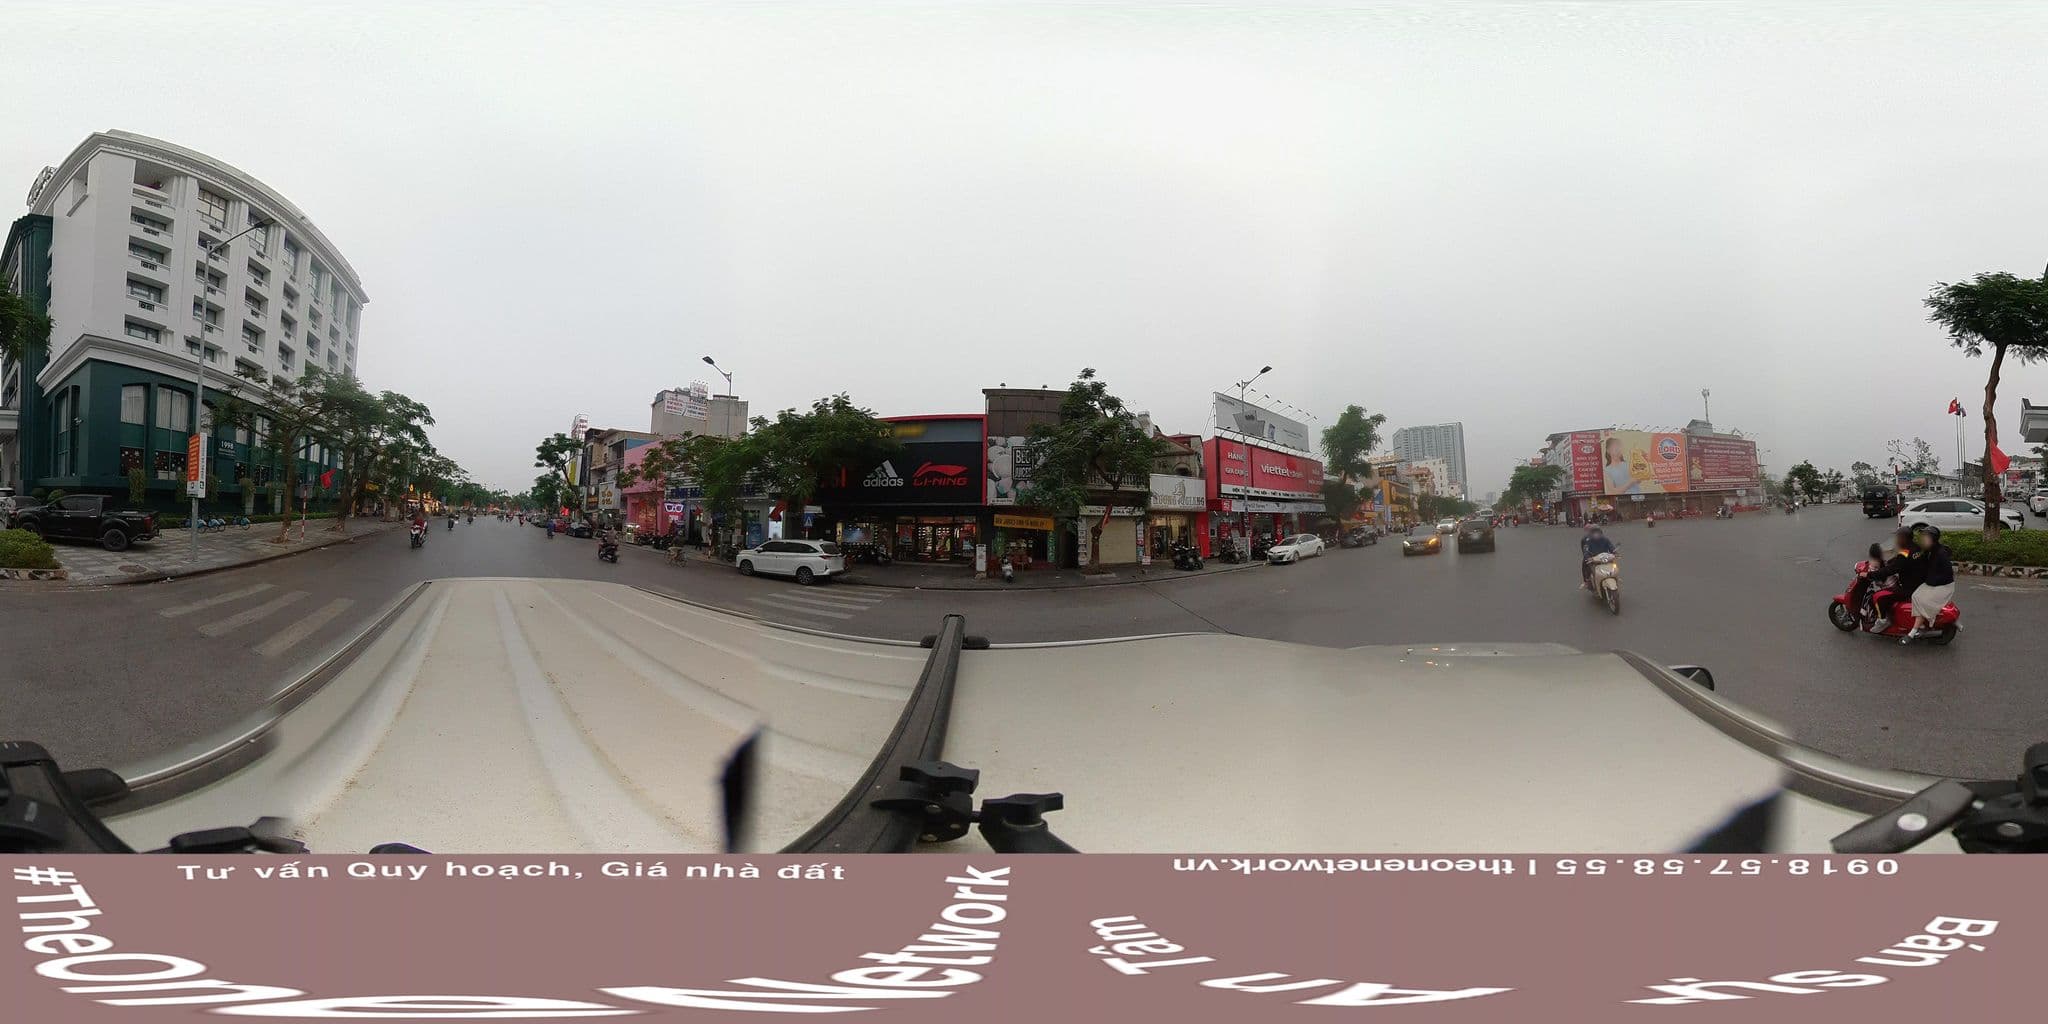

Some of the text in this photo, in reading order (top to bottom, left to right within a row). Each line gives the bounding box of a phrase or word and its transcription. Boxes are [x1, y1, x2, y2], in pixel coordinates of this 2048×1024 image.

[1261, 463, 1290, 477] viettel
[862, 476, 904, 488] adidas
[912, 477, 968, 487] LI-NING
